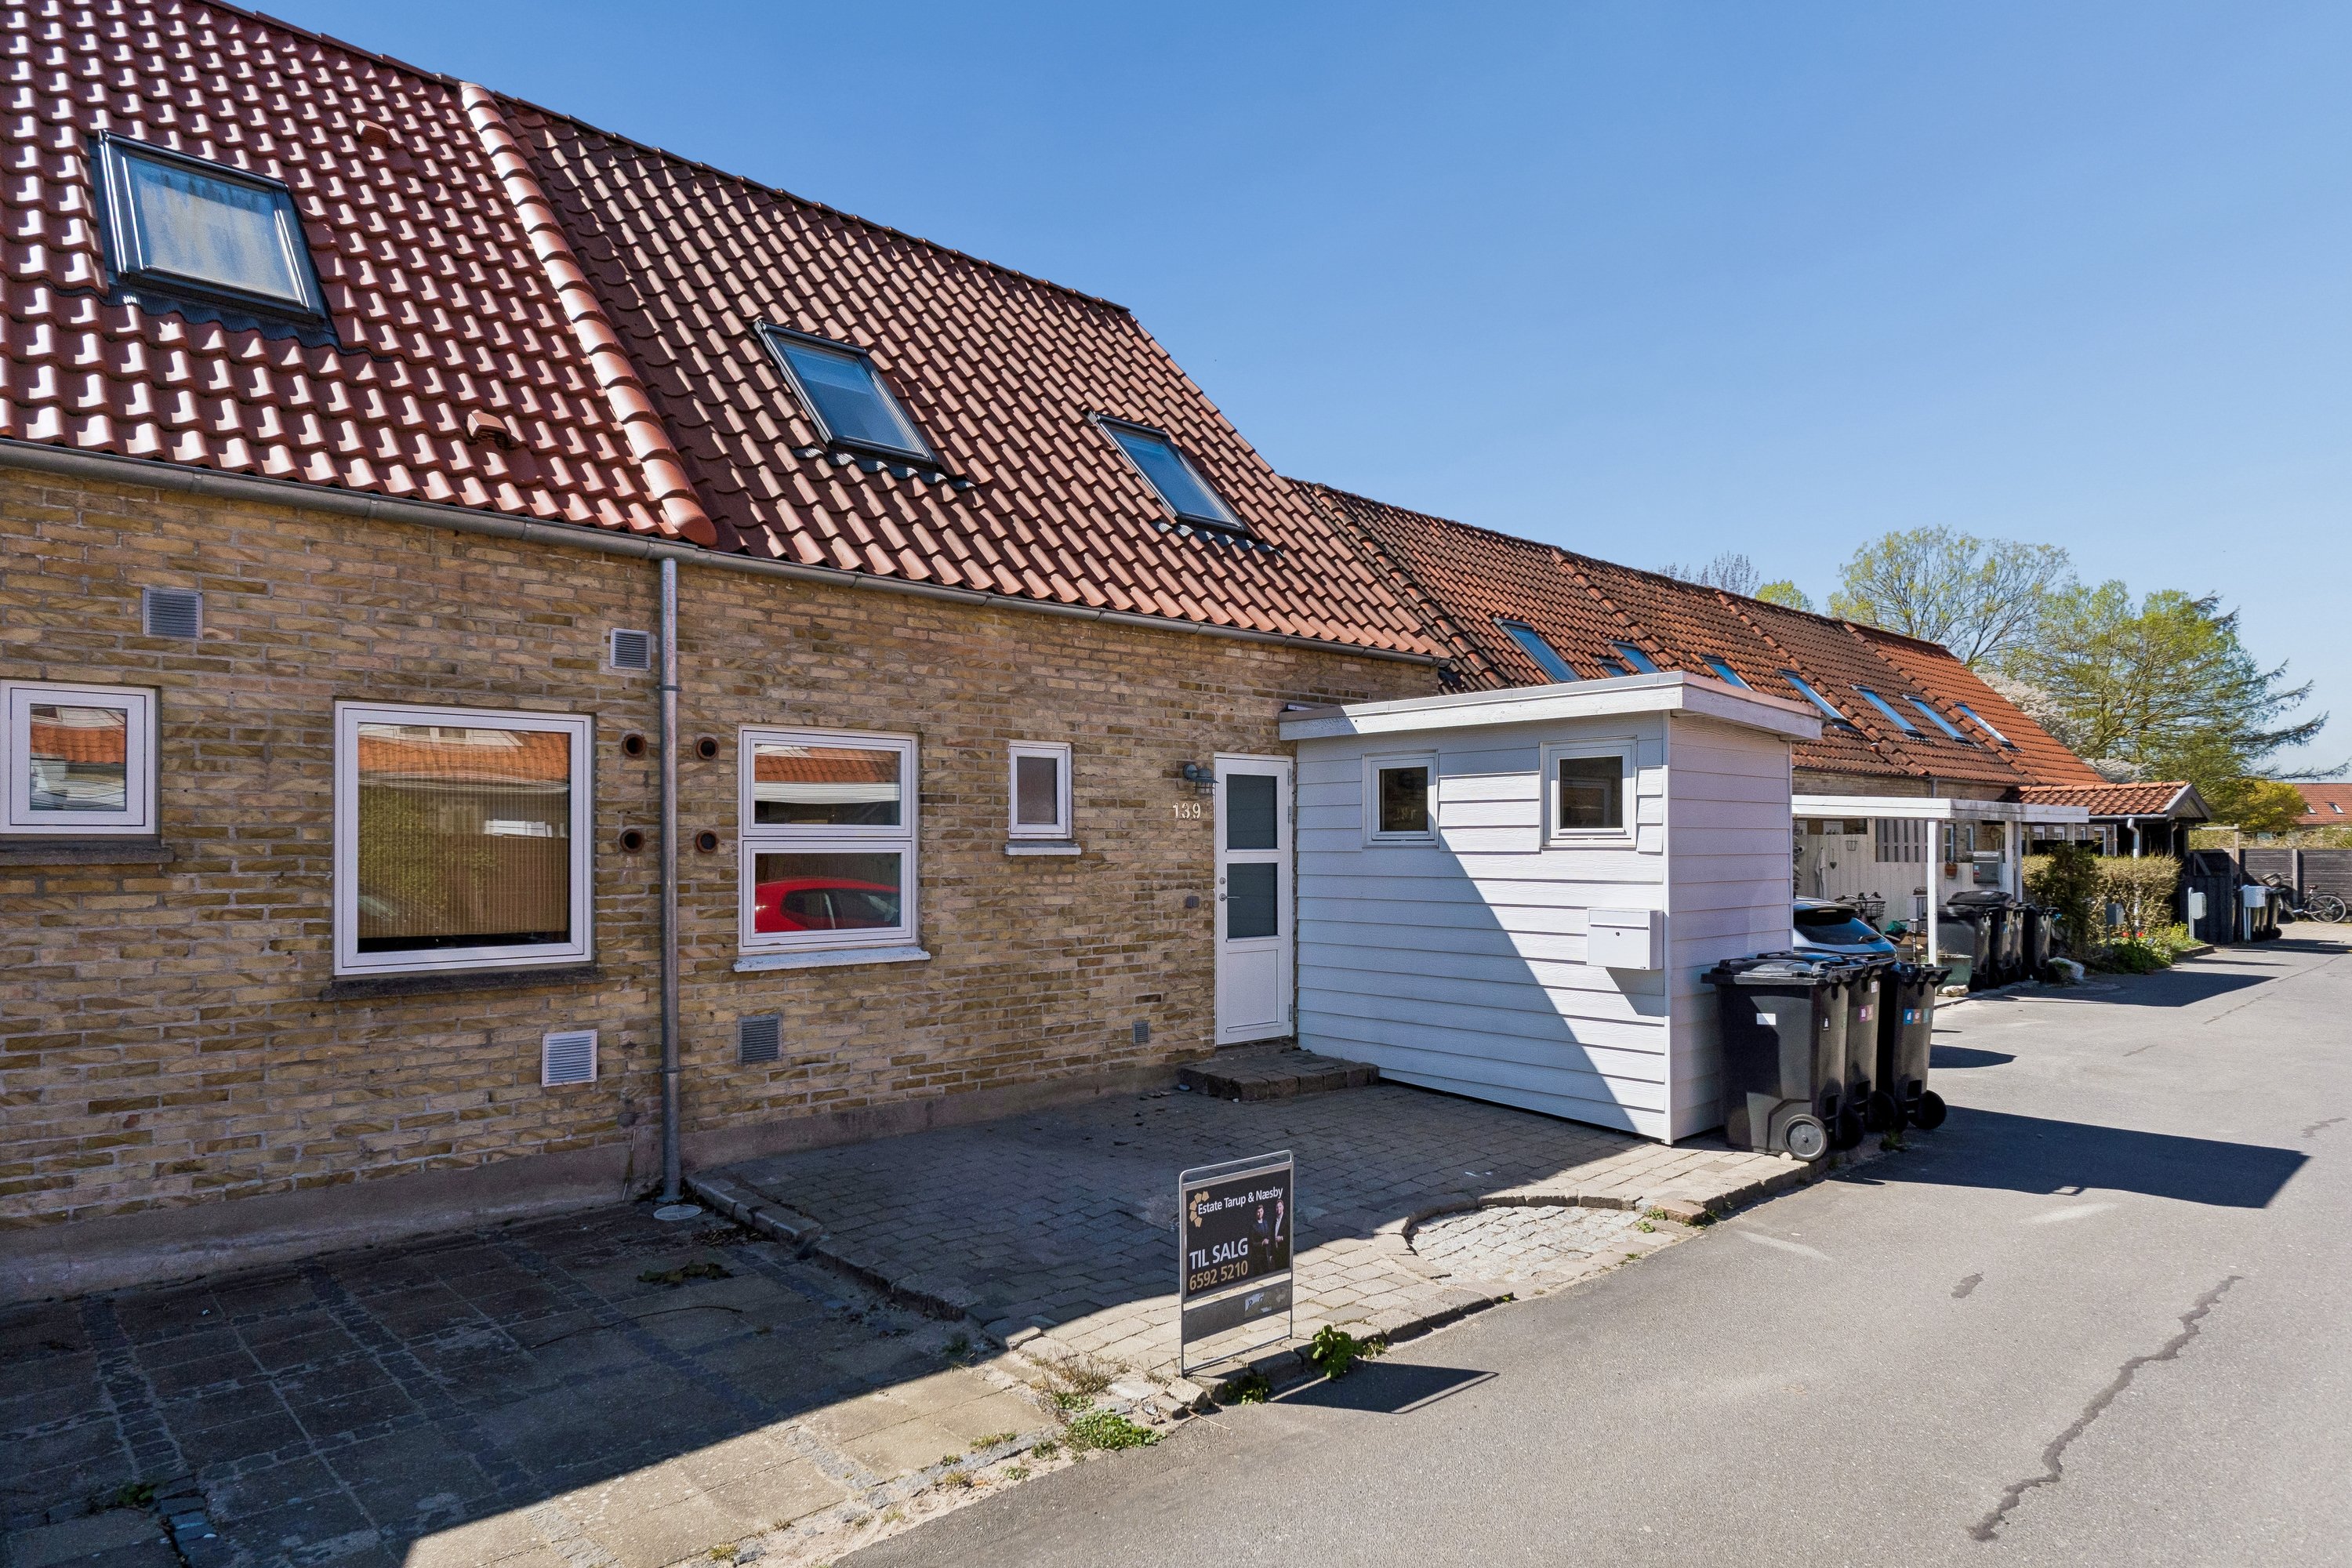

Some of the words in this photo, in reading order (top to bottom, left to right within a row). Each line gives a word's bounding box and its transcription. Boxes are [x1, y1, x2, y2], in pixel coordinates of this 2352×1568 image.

[1173, 802, 1201, 819] 139
[1198, 1200, 1222, 1215] Estate
[1224, 1196, 1246, 1207] Tarup
[1247, 1192, 1254, 1203] &
[1255, 1186, 1283, 1201] Næsby
[1189, 1248, 1209, 1270] TIL
[1212, 1237, 1248, 1264] SALG
[1189, 1269, 1218, 1290] 6592
[1221, 1260, 1248, 1282] 5210
